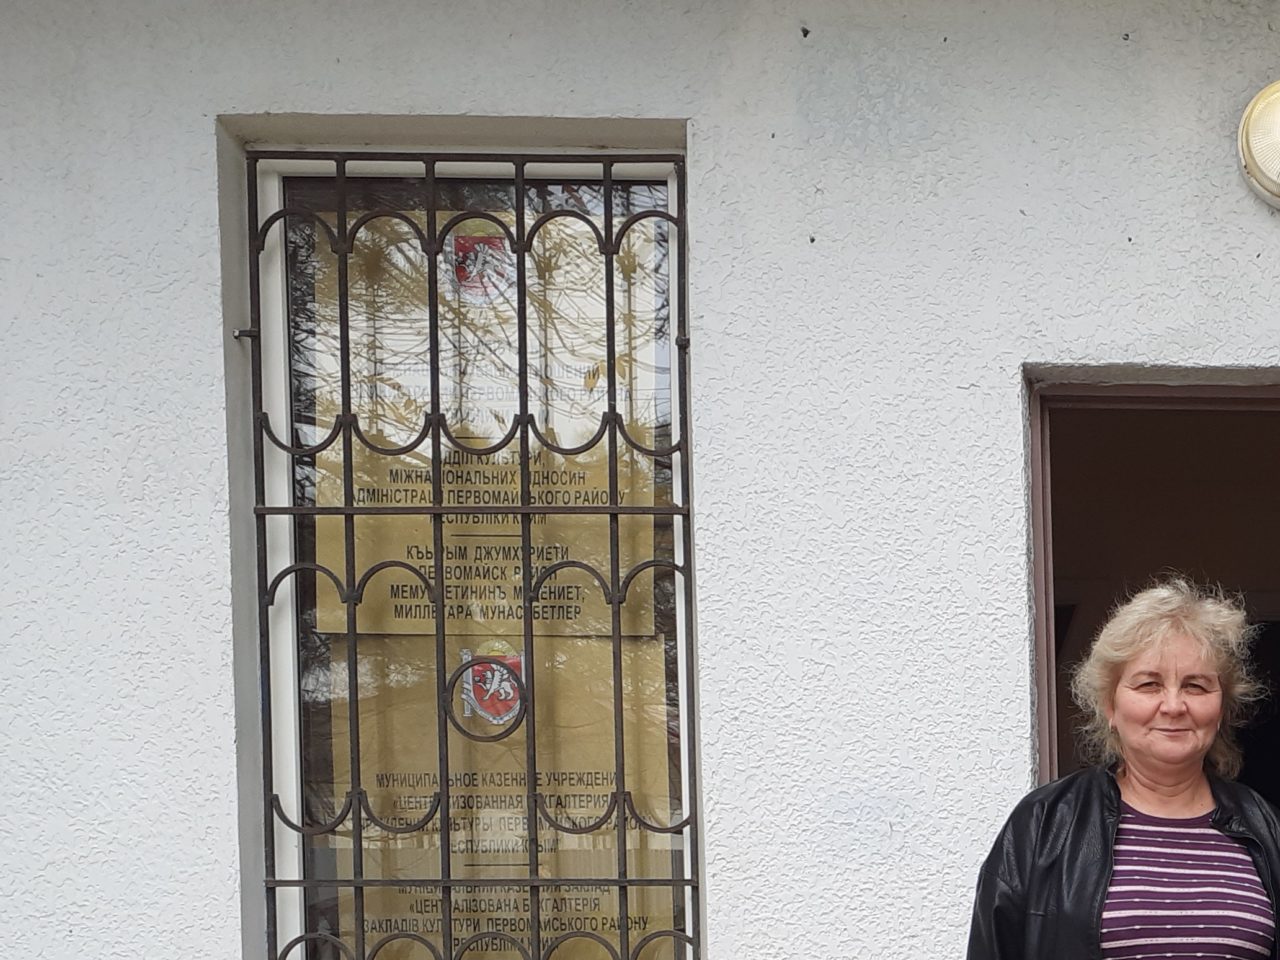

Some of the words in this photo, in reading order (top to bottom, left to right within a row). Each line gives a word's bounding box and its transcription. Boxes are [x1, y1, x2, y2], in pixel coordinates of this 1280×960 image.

[389, 468, 517, 485] МІЖНАІОНАЛЬНИХ
[447, 487, 571, 505] ПЕРВОМАЙЬКОГО
[574, 486, 625, 505] РАЙОУ
[419, 564, 507, 580] ПЕВОМАЙСК
[480, 605, 582, 621] МУНАСБЕТЛЕР
[376, 772, 478, 790] МУНИЦИПАЬНОЕ
[482, 772, 542, 787] КАЗЕННЕ
[523, 897, 600, 913] БХГАЛТЕРІЯ
[423, 917, 480, 933] КУЛТУРИ
